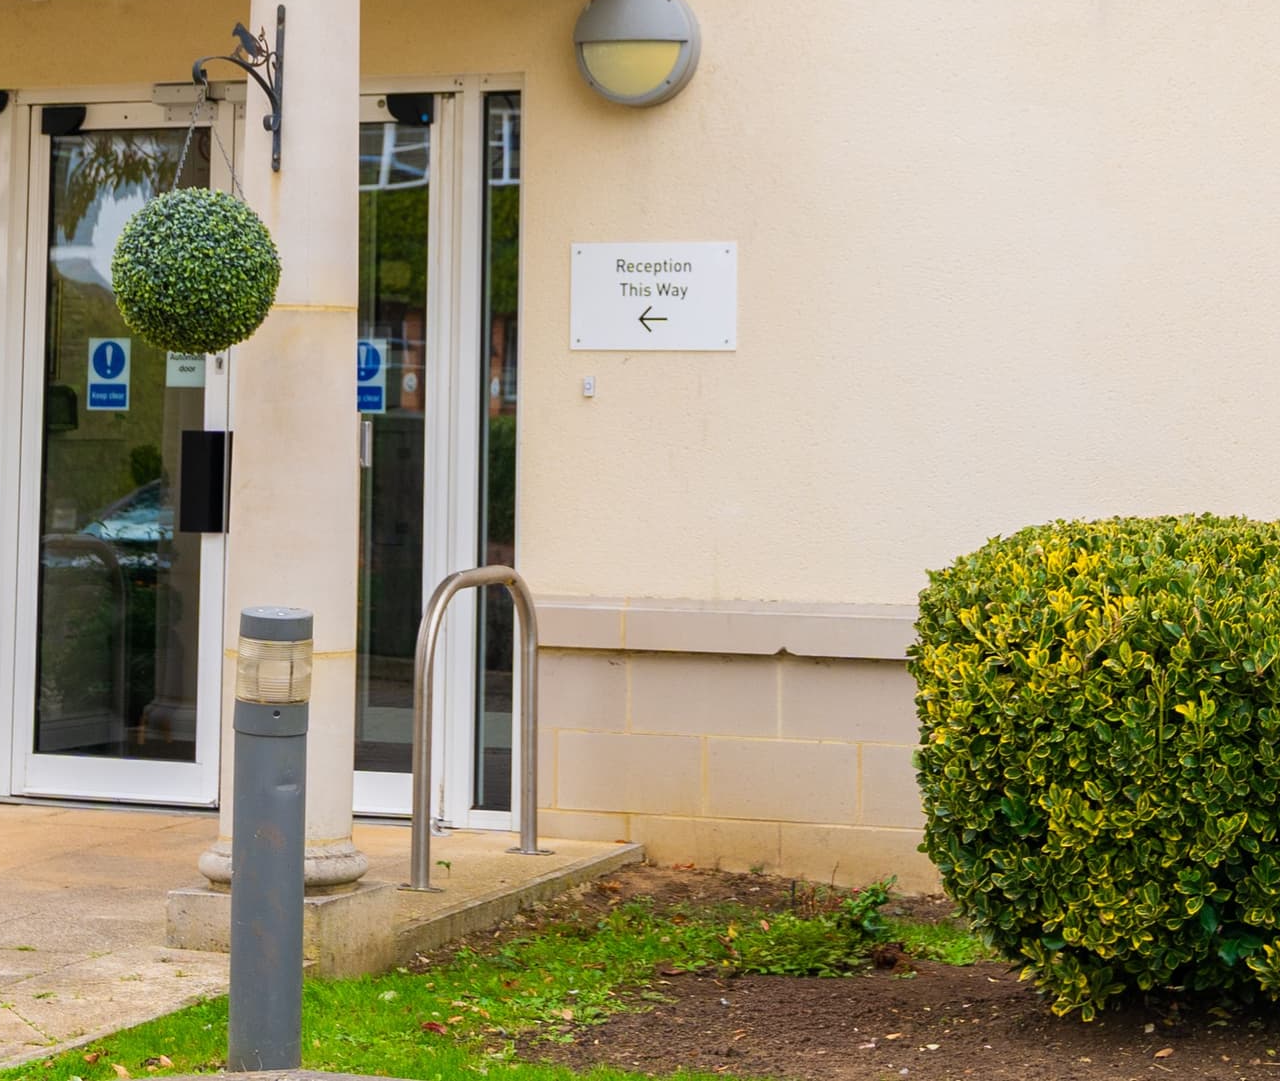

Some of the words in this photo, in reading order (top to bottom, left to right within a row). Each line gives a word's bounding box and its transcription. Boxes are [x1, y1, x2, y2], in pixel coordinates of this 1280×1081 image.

[615, 257, 692, 276] Reception
[620, 283, 652, 297] This
[656, 283, 689, 300] Way
[179, 363, 197, 373] door
[91, 391, 107, 401] Keep
[109, 391, 125, 400] clear
